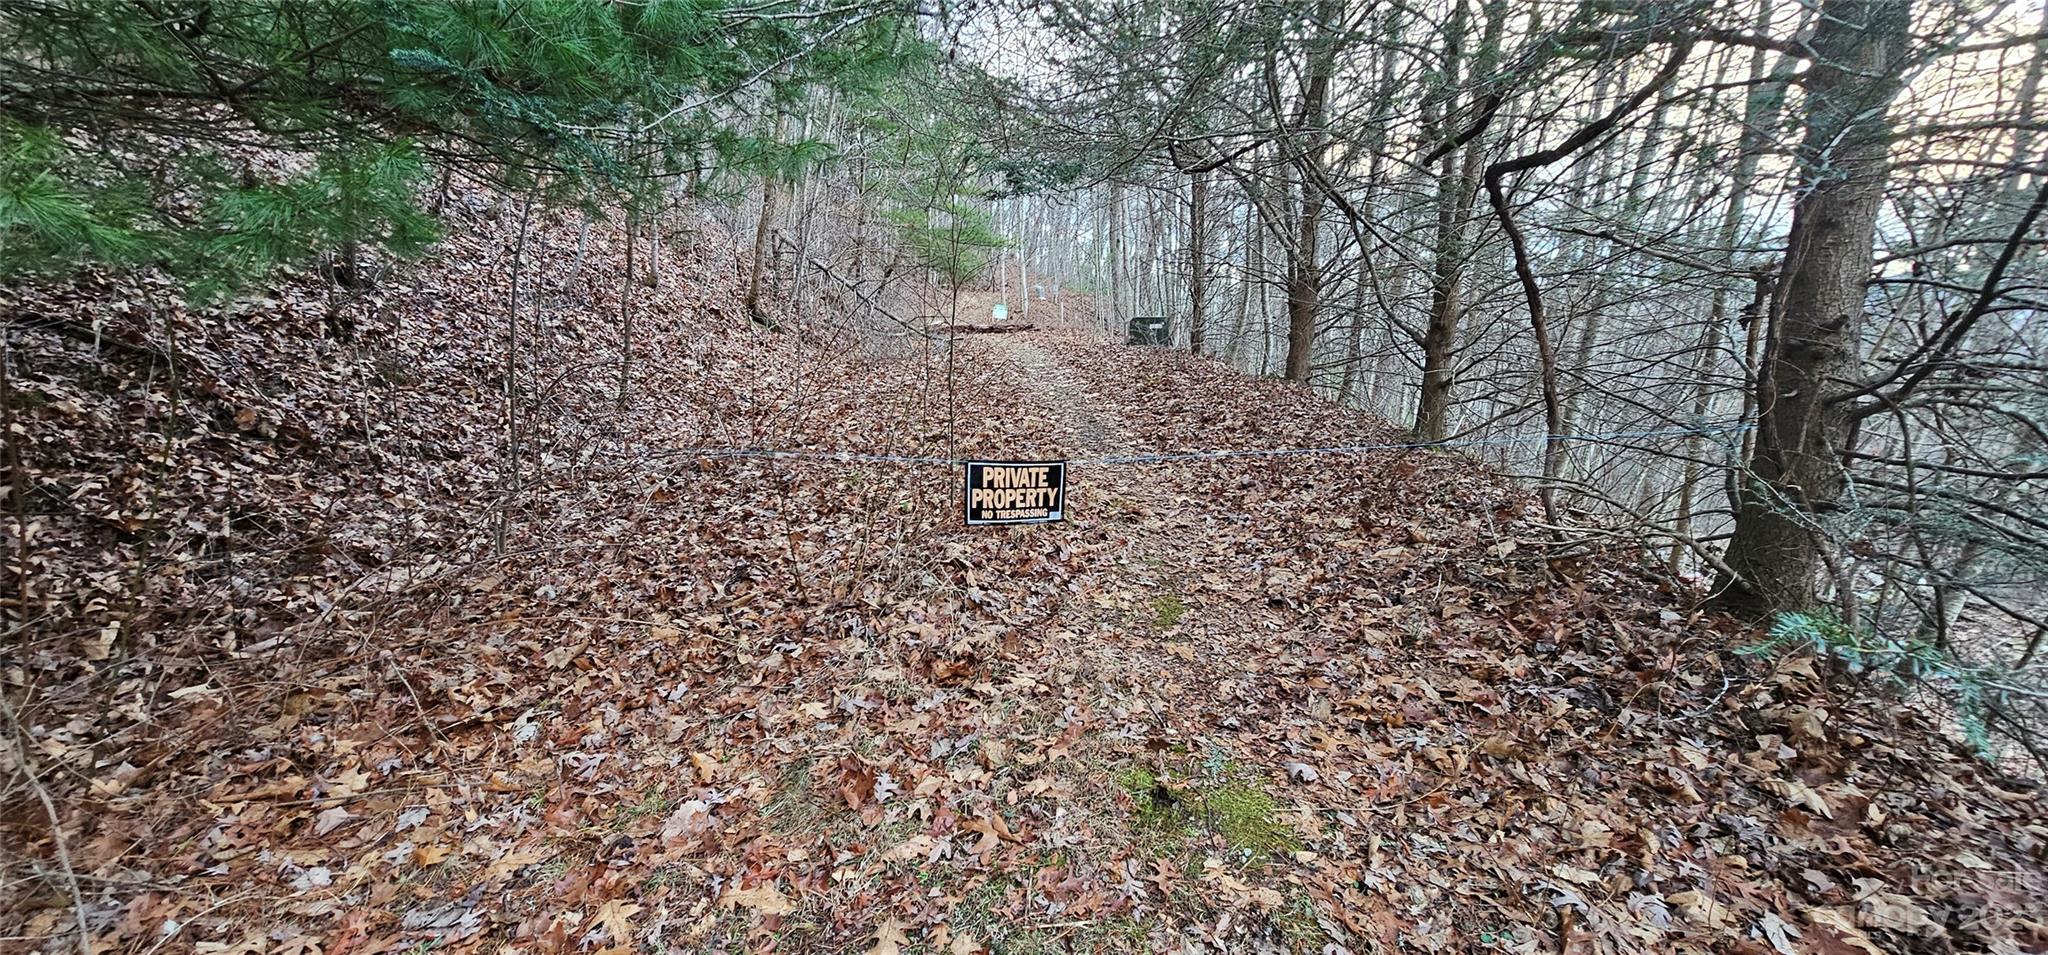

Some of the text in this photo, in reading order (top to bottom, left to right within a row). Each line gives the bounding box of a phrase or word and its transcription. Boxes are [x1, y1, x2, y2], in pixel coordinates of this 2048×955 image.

[982, 466, 1050, 488] PRIVATE
[971, 487, 1058, 509] PROPERTY
[981, 508, 1048, 519] NO TRESPASSING
